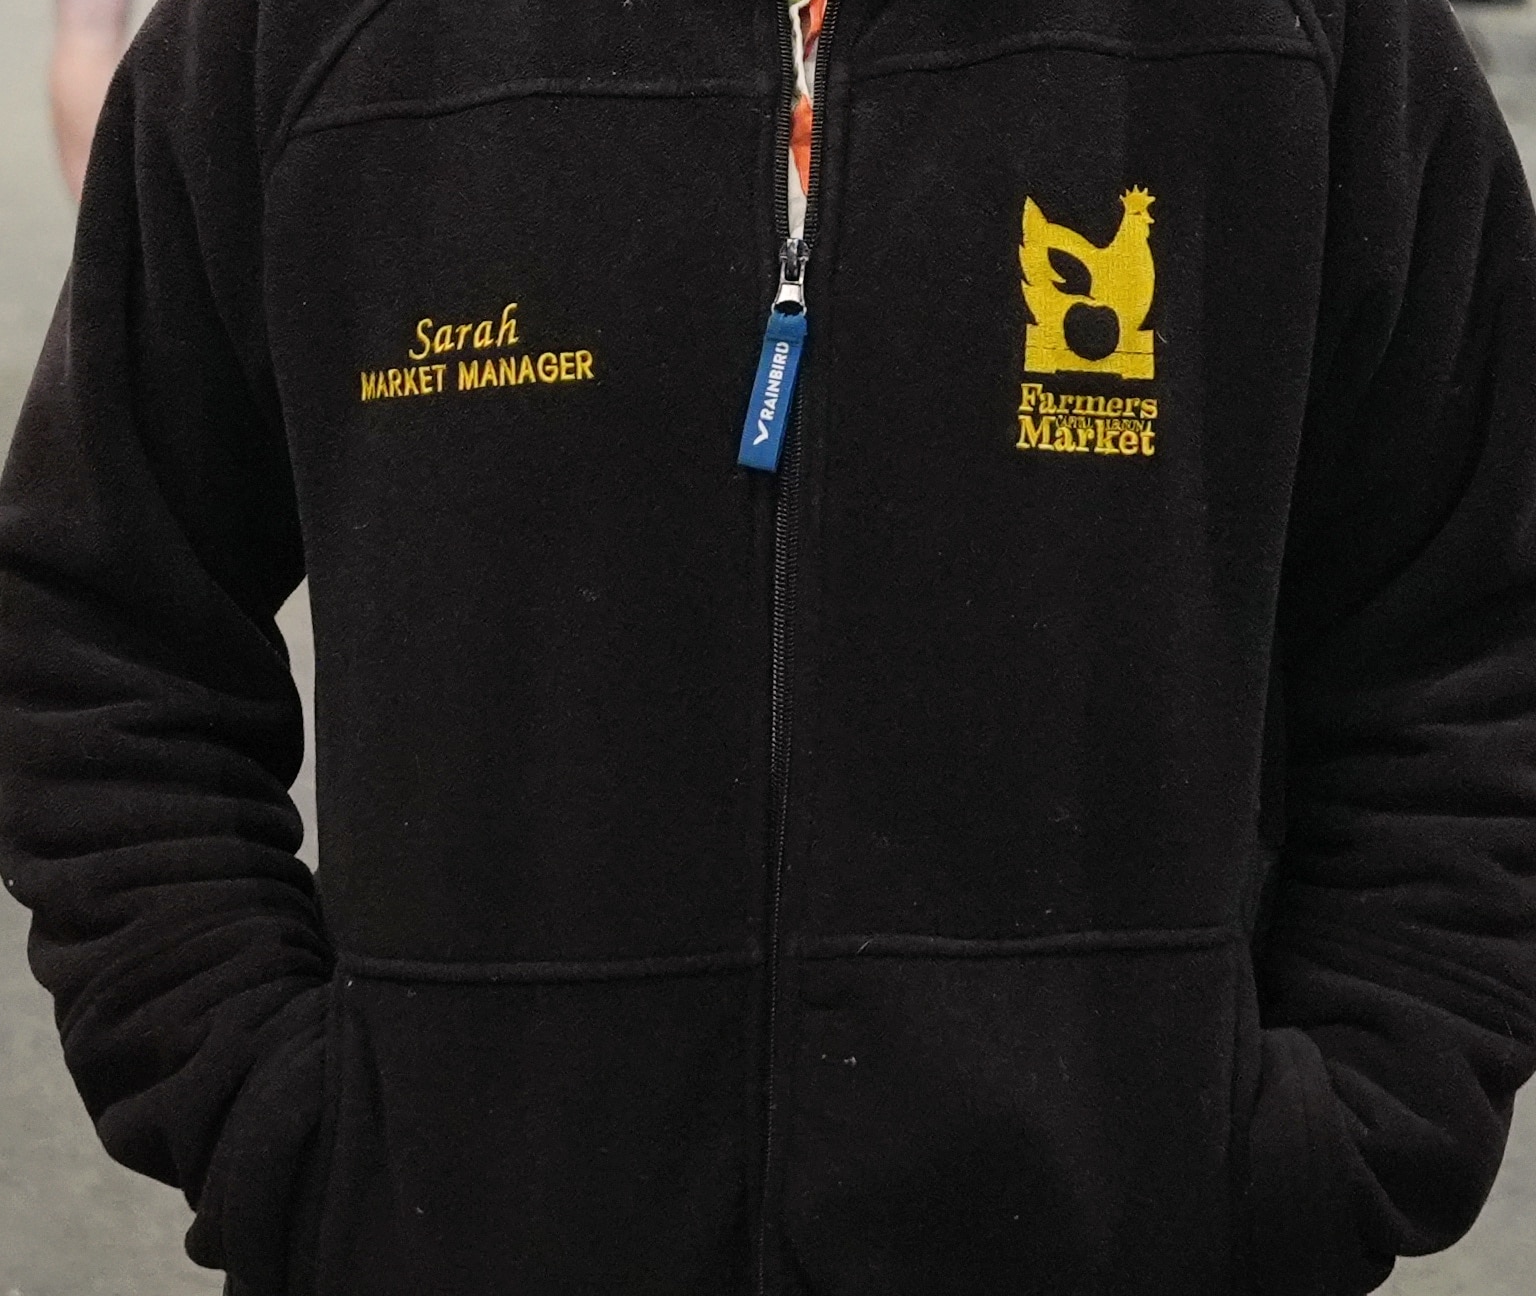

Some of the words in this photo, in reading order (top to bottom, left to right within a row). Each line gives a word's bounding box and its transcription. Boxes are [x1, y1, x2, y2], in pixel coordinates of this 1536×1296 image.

[408, 302, 520, 360] Sarah
[360, 363, 447, 401] MARKET
[457, 349, 595, 391] MANAGER
[759, 341, 790, 421] RAINBIRD
[1018, 382, 1159, 420] Farmers
[1016, 414, 1156, 456] Market
